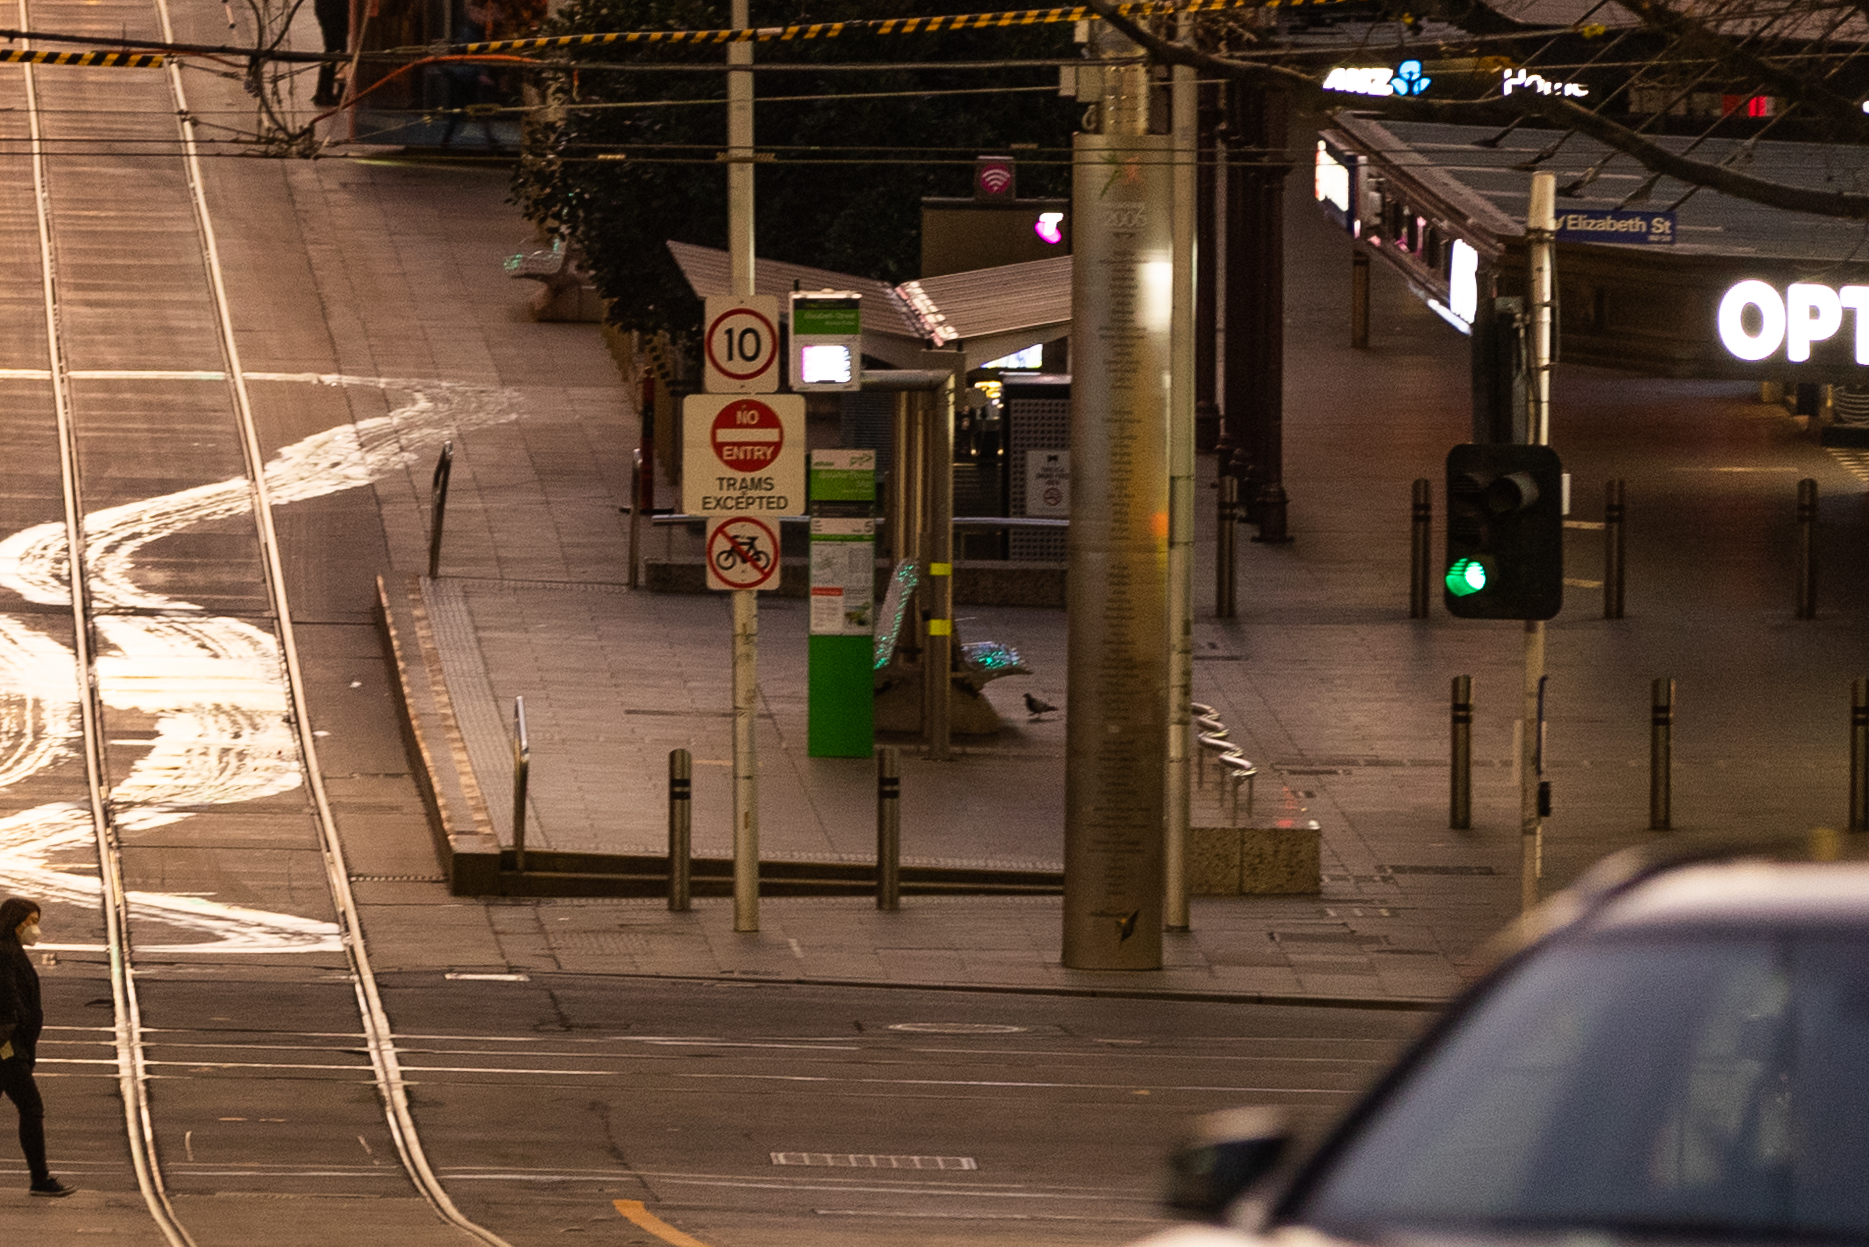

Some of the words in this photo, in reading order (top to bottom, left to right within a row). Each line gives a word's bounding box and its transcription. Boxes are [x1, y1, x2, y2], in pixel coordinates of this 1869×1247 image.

[1323, 68, 1393, 96] ANZ
[1566, 214, 1647, 233] Elizabeth
[1651, 217, 1672, 235] St
[724, 327, 762, 362] 10
[735, 410, 760, 425] NO
[722, 445, 775, 460] ENTRY
[716, 476, 775, 492] TRAMS
[701, 495, 789, 511] EXCEPTED
